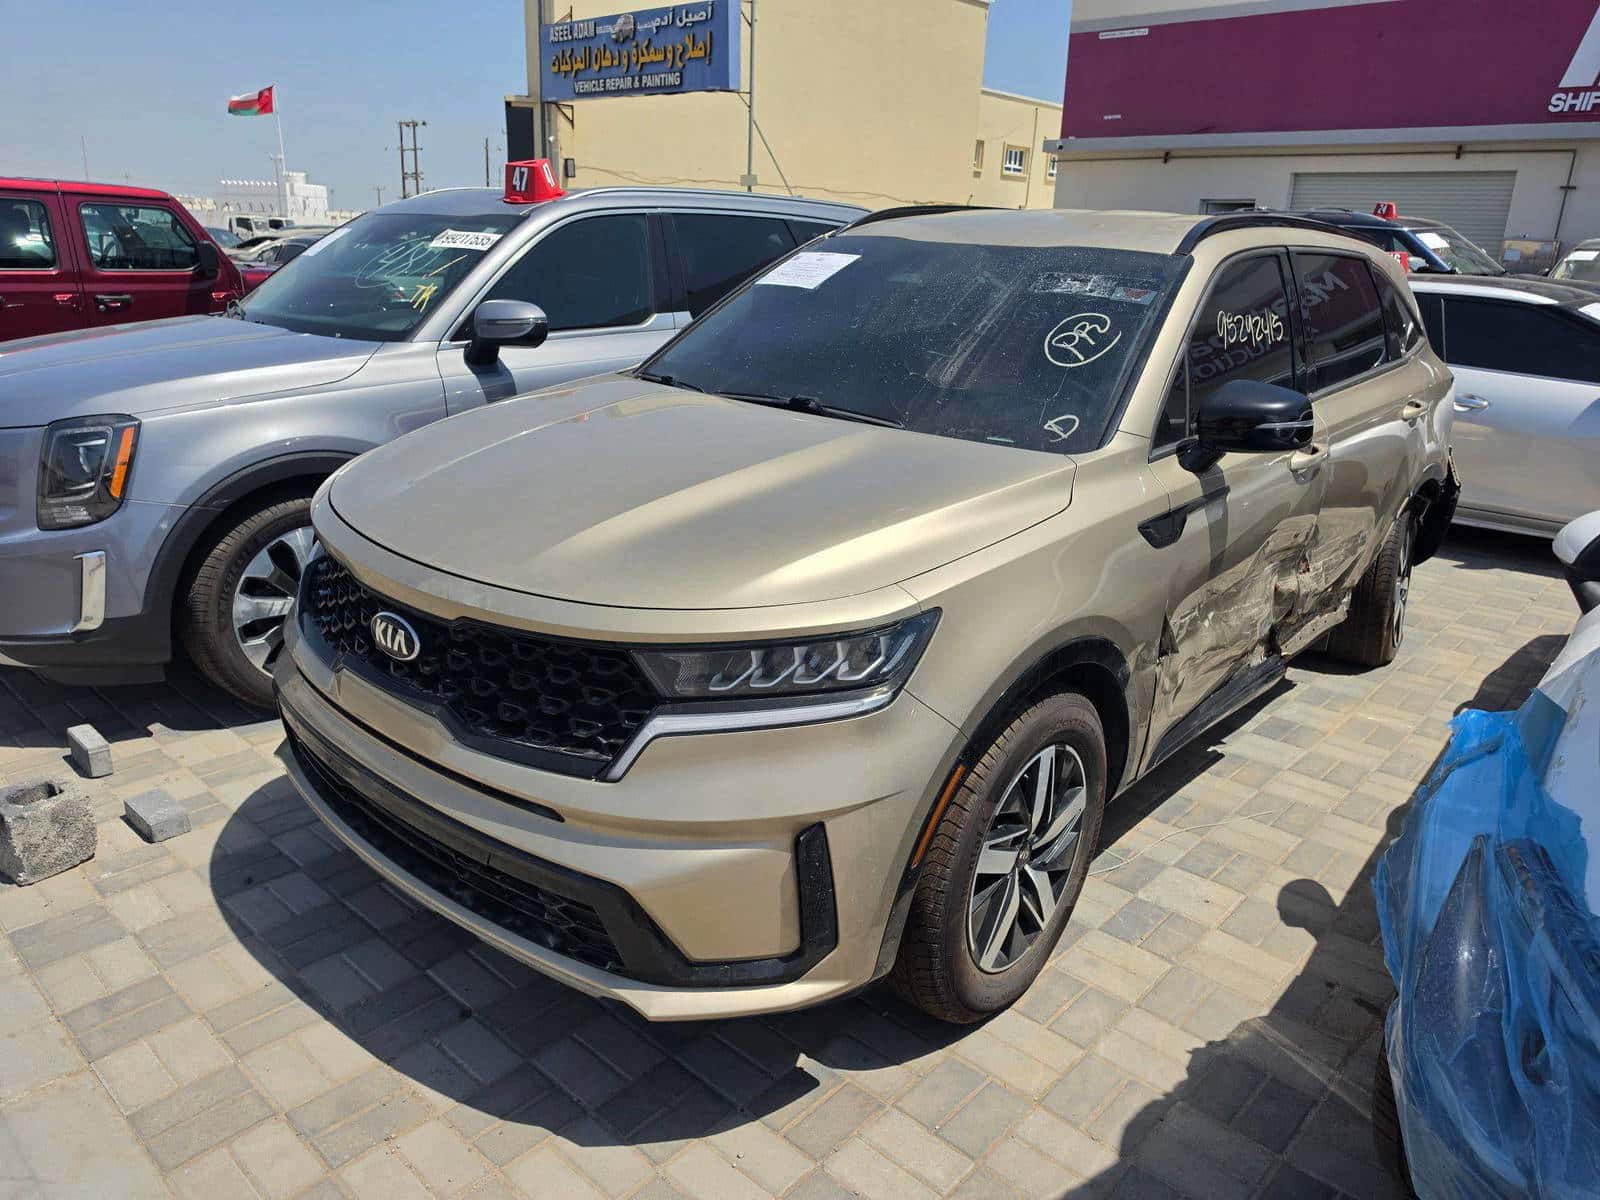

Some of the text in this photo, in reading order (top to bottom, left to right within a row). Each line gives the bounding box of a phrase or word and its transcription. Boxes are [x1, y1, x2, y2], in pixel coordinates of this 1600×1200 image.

[550, 20, 595, 42] ASEEL ADAM
[551, 46, 591, 78] المركبات
[574, 72, 681, 94] VEHICLE REPAIR & PAINTING
[512, 166, 529, 192] 47
[1217, 307, 1284, 350] 95292415
[375, 618, 409, 656] KIA
